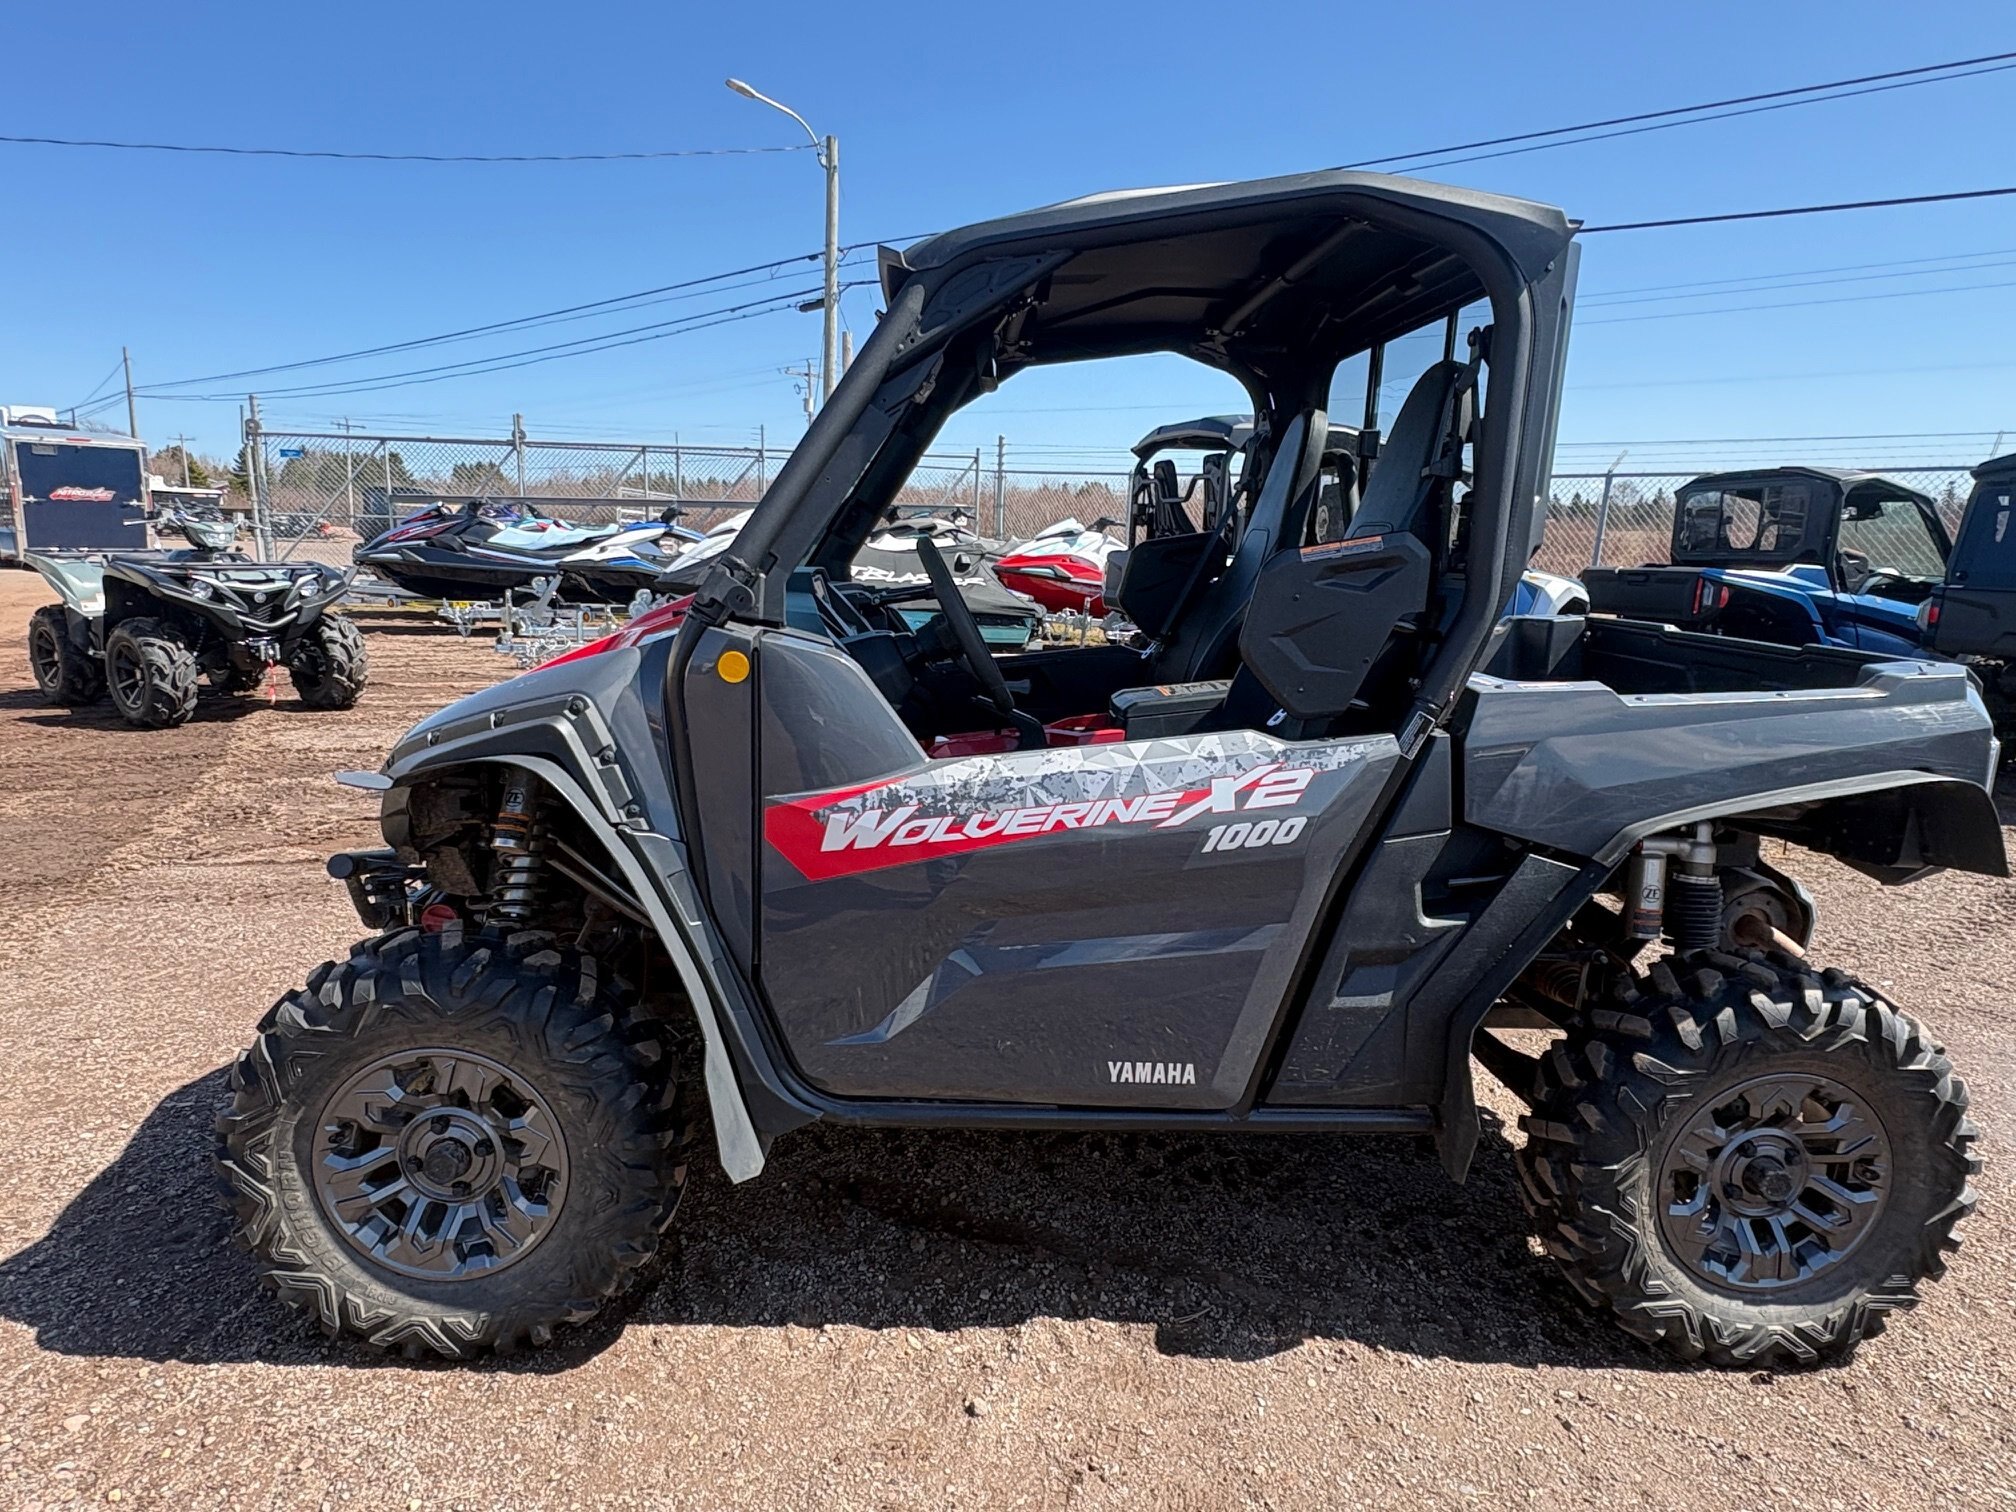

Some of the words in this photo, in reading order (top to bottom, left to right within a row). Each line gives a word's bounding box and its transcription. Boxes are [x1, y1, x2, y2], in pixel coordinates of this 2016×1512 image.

[1154, 762, 1316, 829] X2
[1201, 817, 1308, 854] 1000
[1107, 1061, 1196, 1085] YAMAHA
[278, 1150, 348, 1273] BIGHORN
